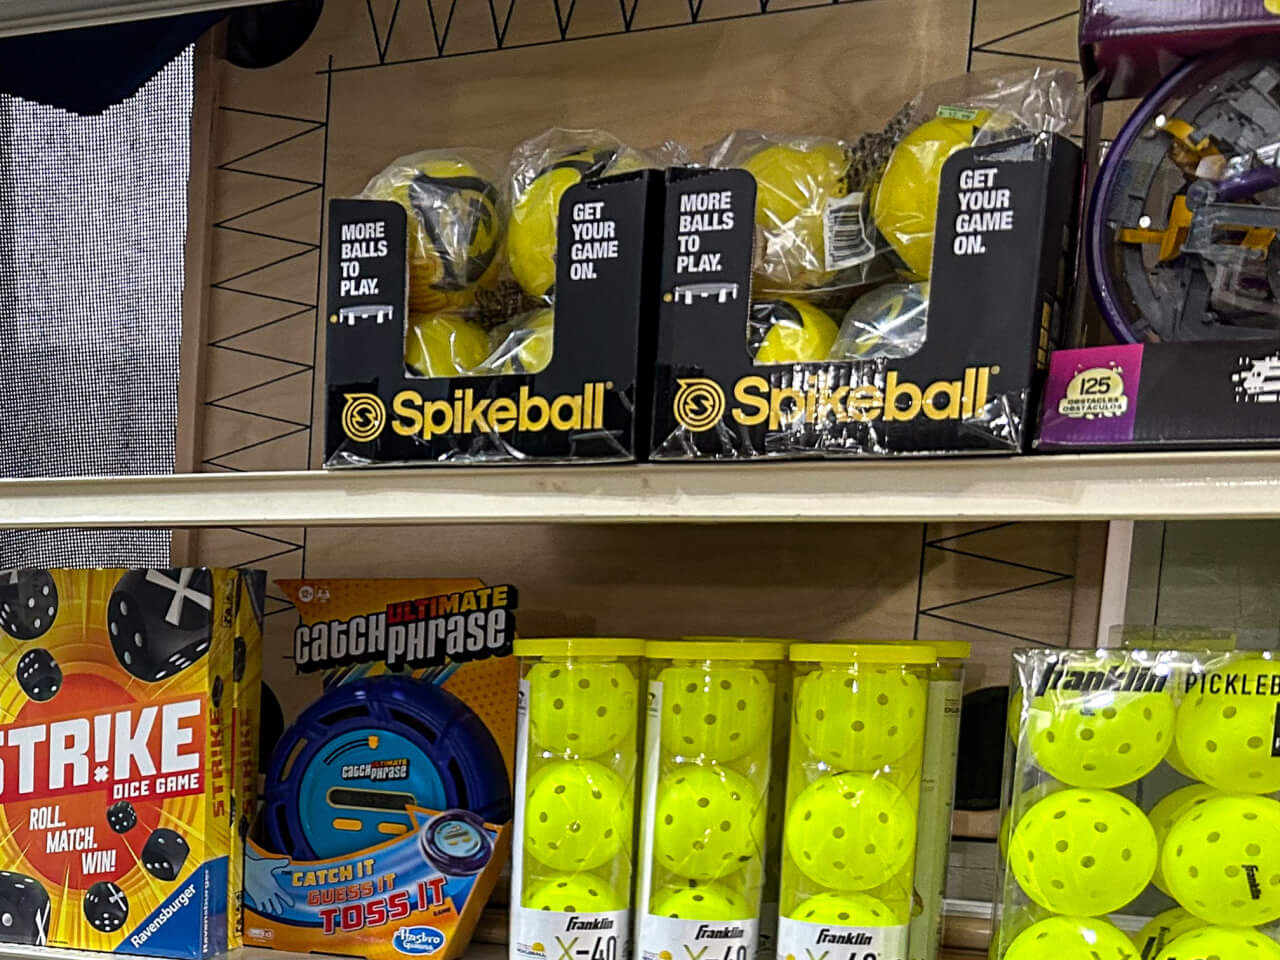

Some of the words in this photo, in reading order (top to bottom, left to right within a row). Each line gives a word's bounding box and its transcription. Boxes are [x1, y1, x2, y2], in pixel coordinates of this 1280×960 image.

[960, 168, 998, 189] GET
[680, 192, 732, 211] MORE
[958, 189, 1010, 210] YOUR
[573, 202, 604, 220] GET
[341, 222, 385, 240] MORE
[572, 222, 616, 240] YOUR
[679, 212, 734, 232] BALLS
[956, 211, 1013, 233] GAME
[341, 240, 388, 259] BALLS
[571, 241, 618, 260] GAME
[678, 235, 700, 253] TO
[954, 235, 986, 256] ON.
[341, 261, 360, 278] TO
[571, 262, 597, 280] ON.
[677, 255, 722, 273] PLAY.
[340, 279, 379, 296] PLAY.
[1080, 377, 1112, 396] 125
[731, 367, 989, 430] Spikeball
[392, 382, 605, 440] Spikeball
[387, 584, 510, 624] ULTIMATE
[113, 778, 150, 800] DICE
[156, 773, 199, 793] GAME
[30, 806, 67, 830] ROLL.
[46, 827, 98, 853] MATCH.
[81, 849, 117, 875] WIN!
[291, 864, 354, 888] CATCH
[357, 859, 375, 879] IT
[308, 880, 373, 906] GUESS
[378, 873, 396, 892] IT
[319, 894, 414, 935] TOSS
[418, 876, 449, 907] IT
[130, 883, 197, 949] Ravensburger
[565, 916, 615, 932] Franklin
[694, 923, 745, 941] Franklin
[815, 928, 873, 946] Franklin
